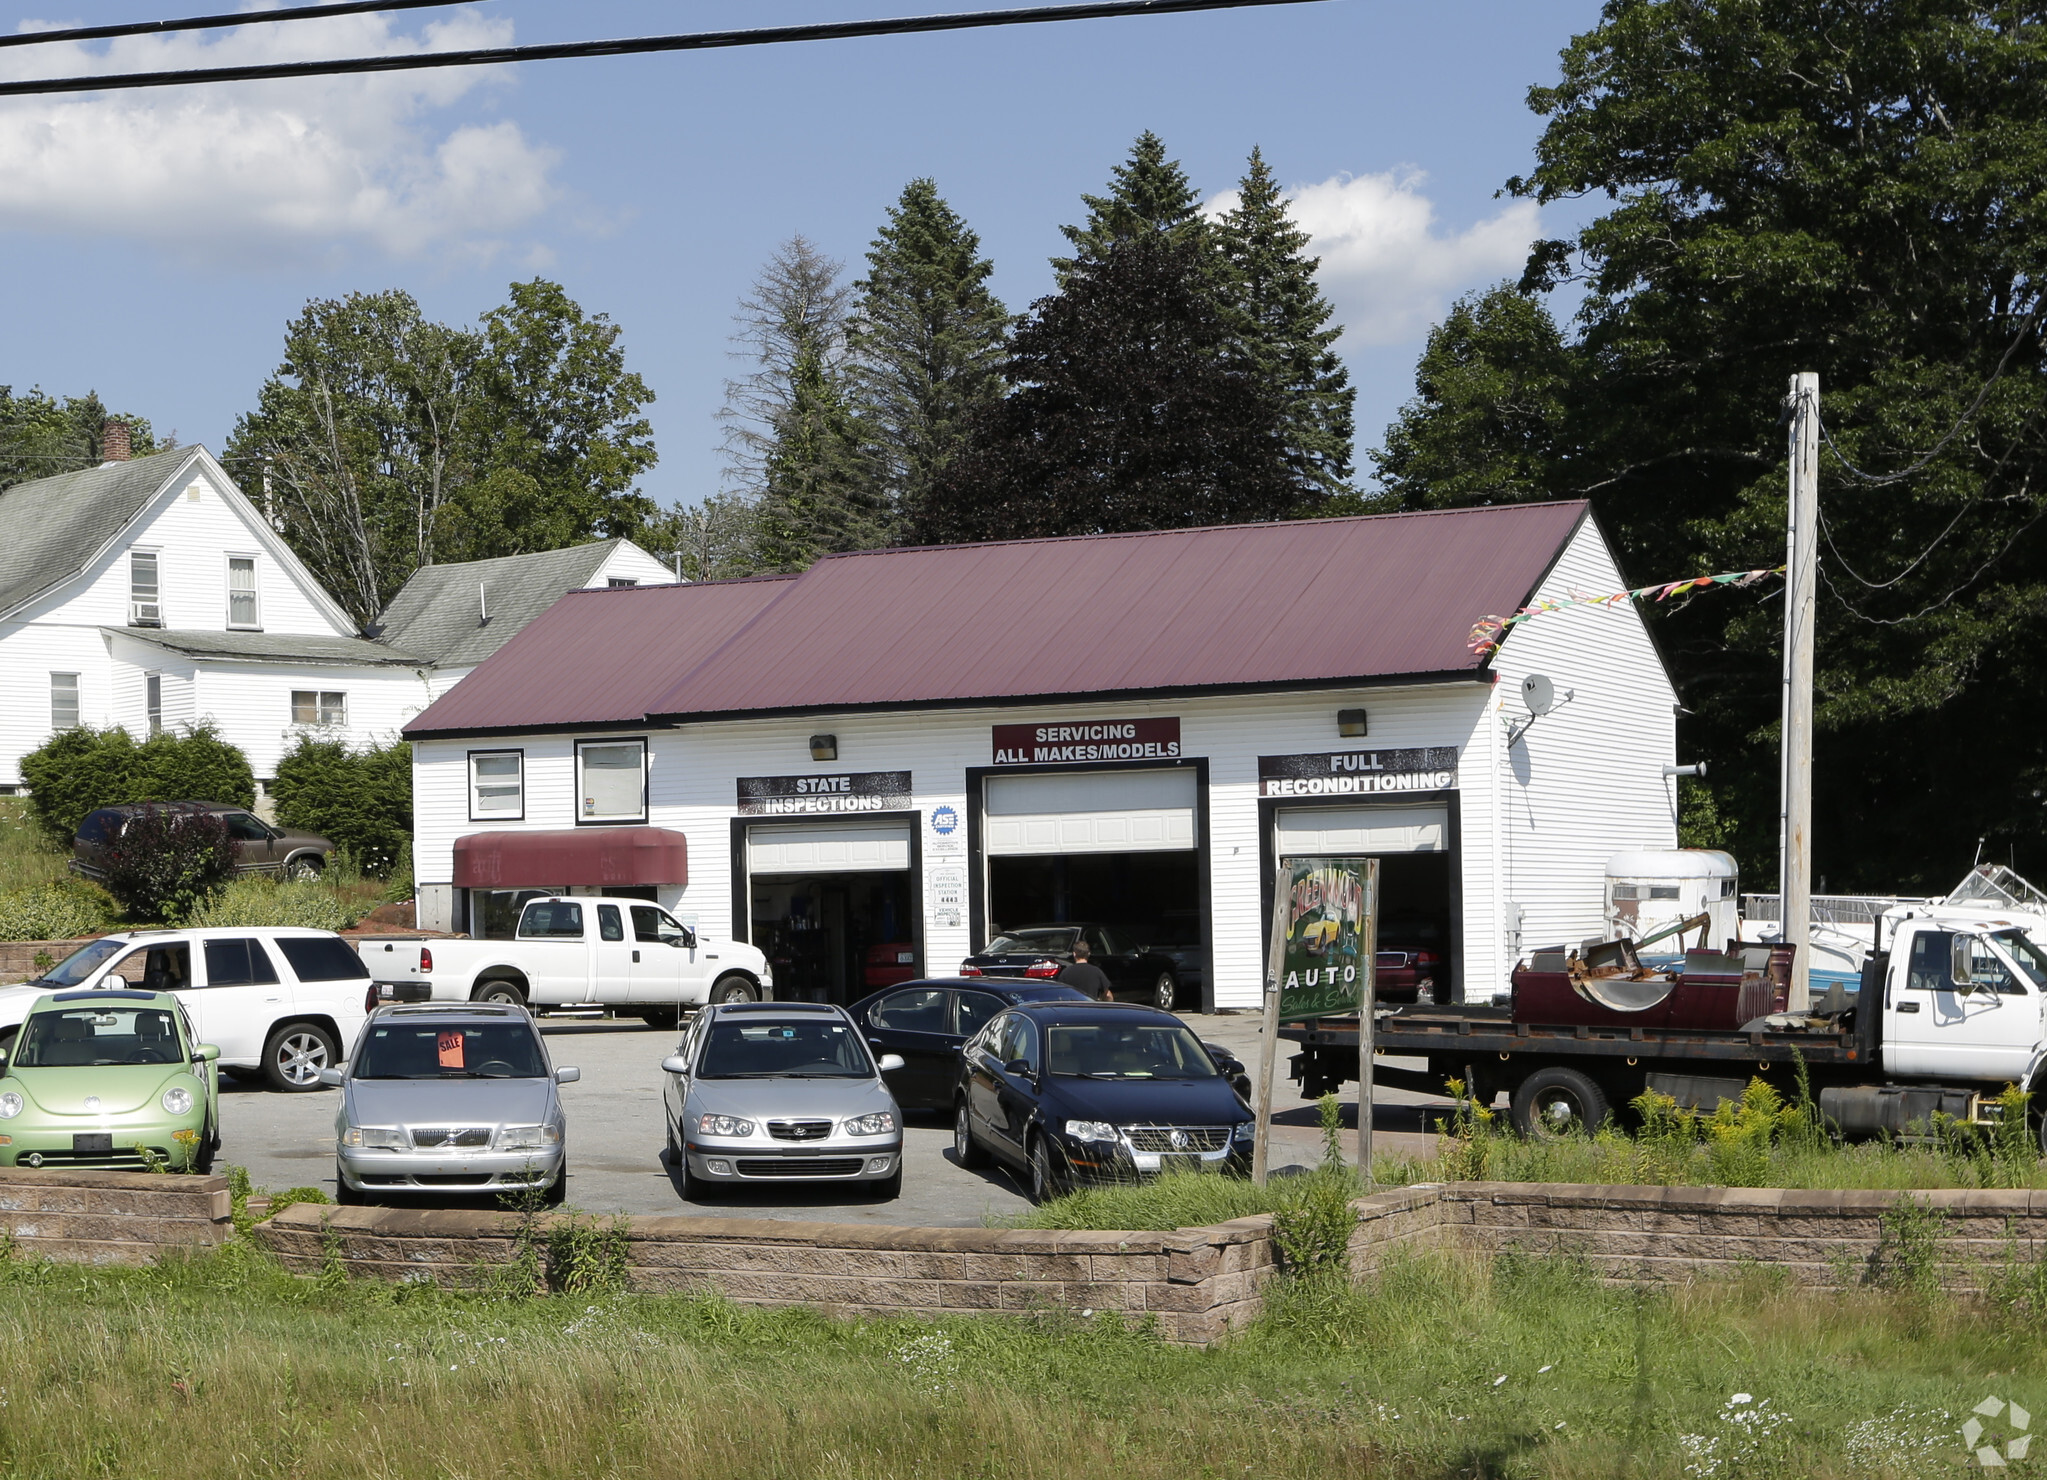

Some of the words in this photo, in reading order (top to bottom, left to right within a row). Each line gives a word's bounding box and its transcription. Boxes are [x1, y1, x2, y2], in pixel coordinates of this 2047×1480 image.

[1035, 724, 1136, 743] SERVICING
[995, 748, 1029, 764] ALL
[1034, 742, 1179, 761] MAKES/MODELS
[1330, 753, 1384, 772] FULL
[796, 777, 851, 794] STATE
[1266, 771, 1451, 795] RECONDITIONING
[765, 795, 883, 813] INSPECTIONS
[934, 813, 955, 825] ASE
[1285, 965, 1356, 989] AUTO
[1311, 992, 1321, 1009] &
[439, 1037, 460, 1052] SALE
